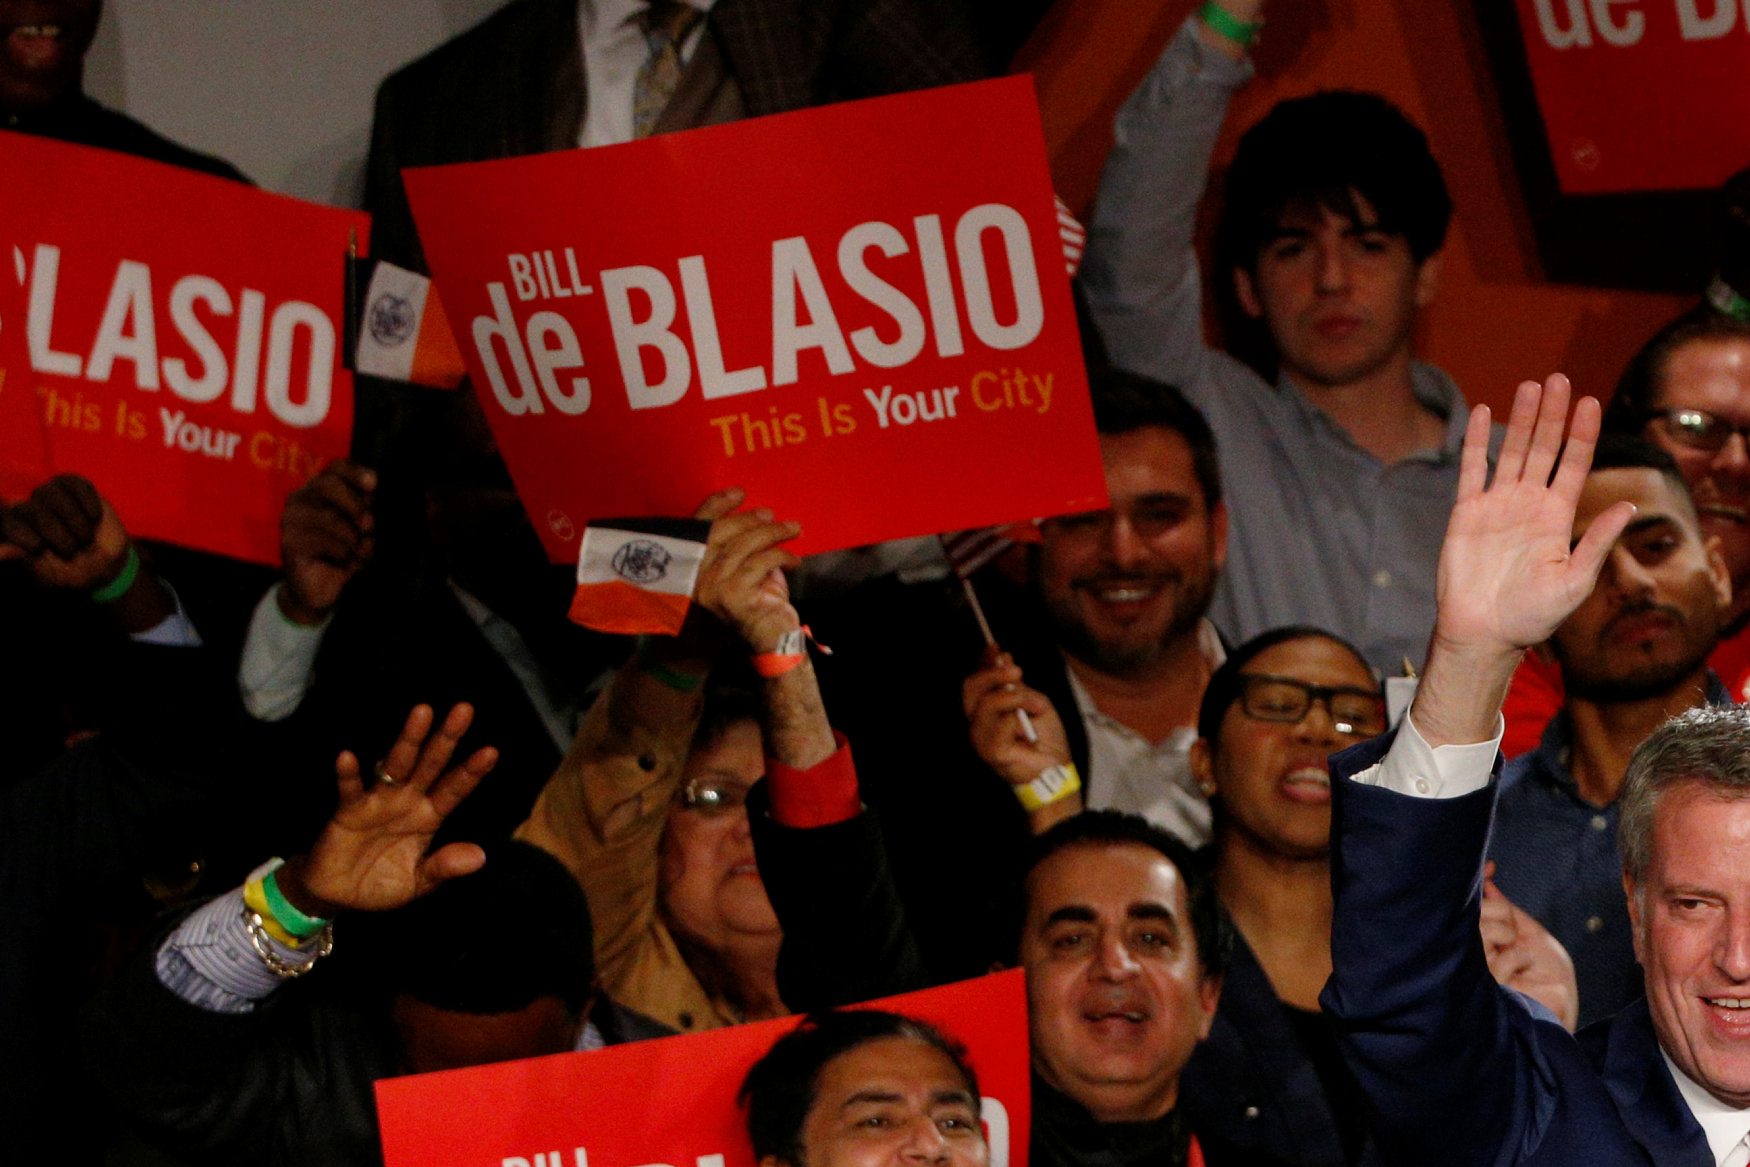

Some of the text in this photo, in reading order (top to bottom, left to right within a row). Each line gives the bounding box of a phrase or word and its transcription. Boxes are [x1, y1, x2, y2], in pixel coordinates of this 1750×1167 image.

[471, 202, 1045, 416] de BLASIO
[508, 247, 593, 301] BILL
[13, 243, 337, 428] LASIO
[115, 400, 147, 440] Is
[160, 406, 241, 460] Your
[711, 369, 1056, 458] This Is Your City
